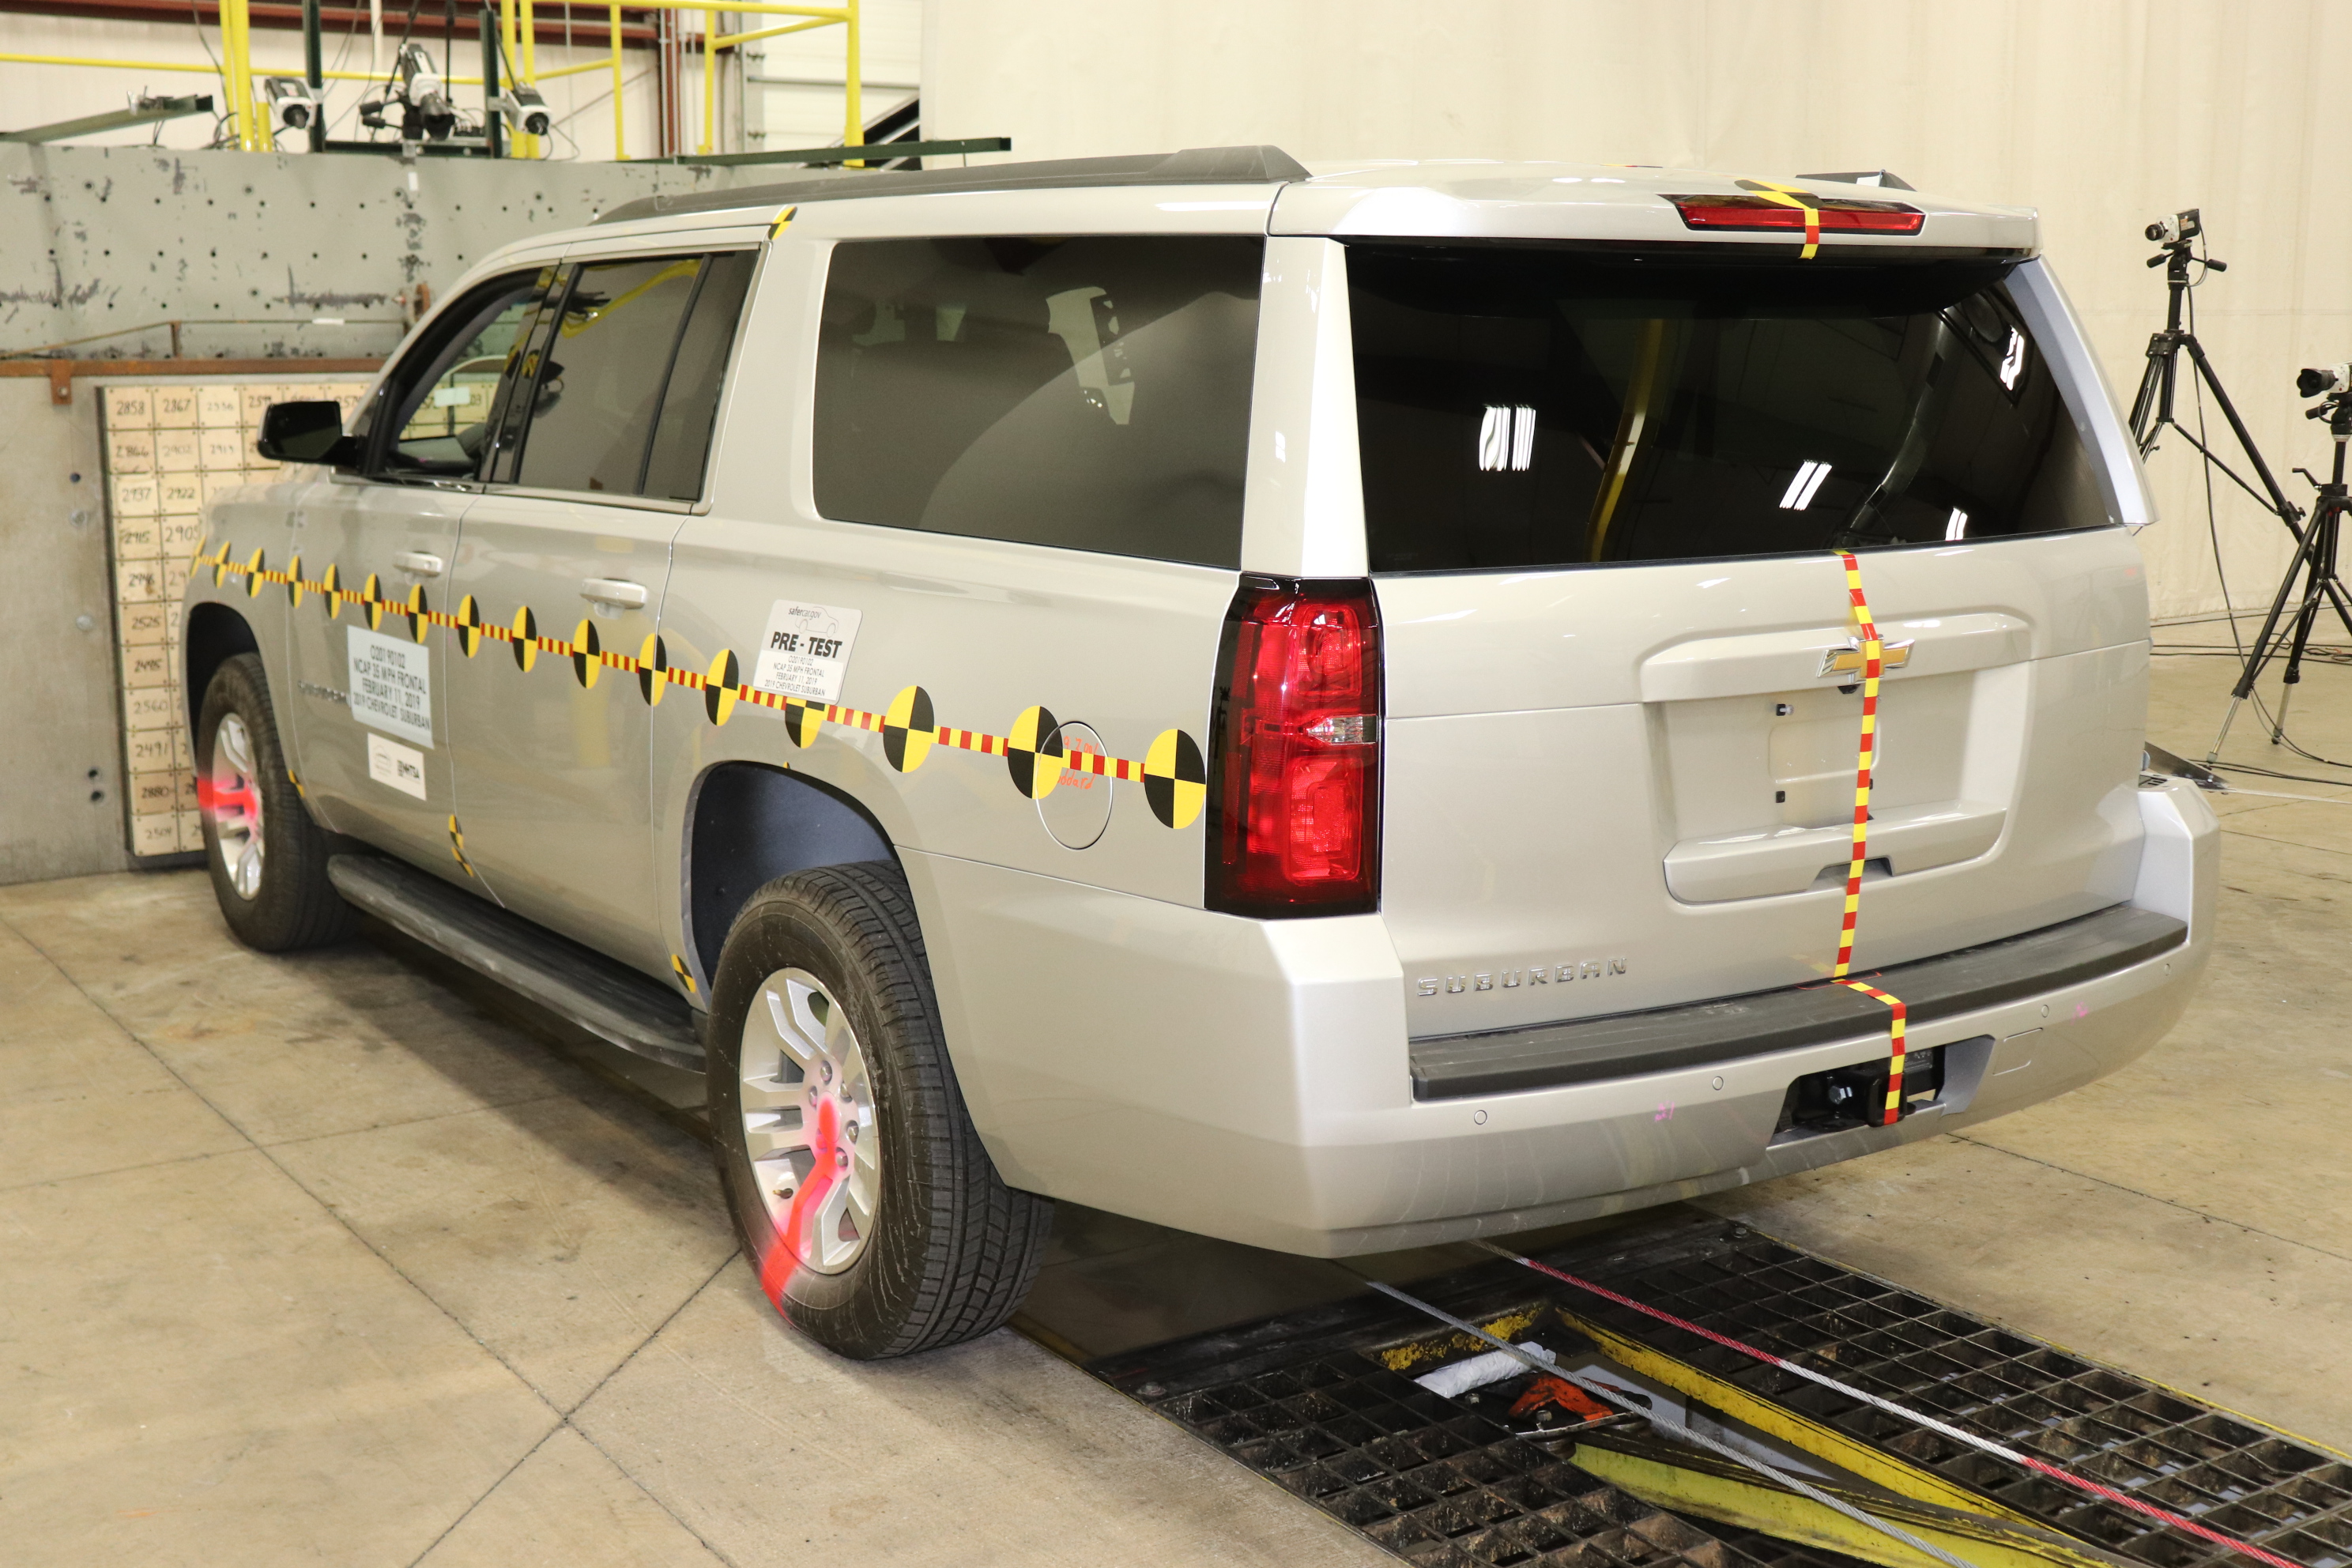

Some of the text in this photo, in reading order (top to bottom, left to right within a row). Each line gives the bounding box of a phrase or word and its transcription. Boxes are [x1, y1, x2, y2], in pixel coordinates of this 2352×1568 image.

[116, 400, 145, 416] 2858
[163, 398, 190, 413] 2867
[788, 606, 822, 620] safercar.gov
[771, 631, 799, 652] PRE
[808, 637, 842, 658] TEST
[353, 657, 426, 695] NCAP 35 MPH FRONTAL
[773, 662, 824, 677] NCAP 35 MPH FRONTAL
[764, 679, 826, 696] 2019 CHEVROLET SUBURBAN
[775, 672, 797, 683] FEBRUARY
[805, 677, 818, 686] 2019
[362, 677, 392, 700] FEBRUARY
[405, 692, 420, 710] 2019
[366, 695, 397, 718] CHEVROLET
[400, 707, 430, 729] SUBURBAN
[1417, 957, 1627, 997] SUBURBAN
